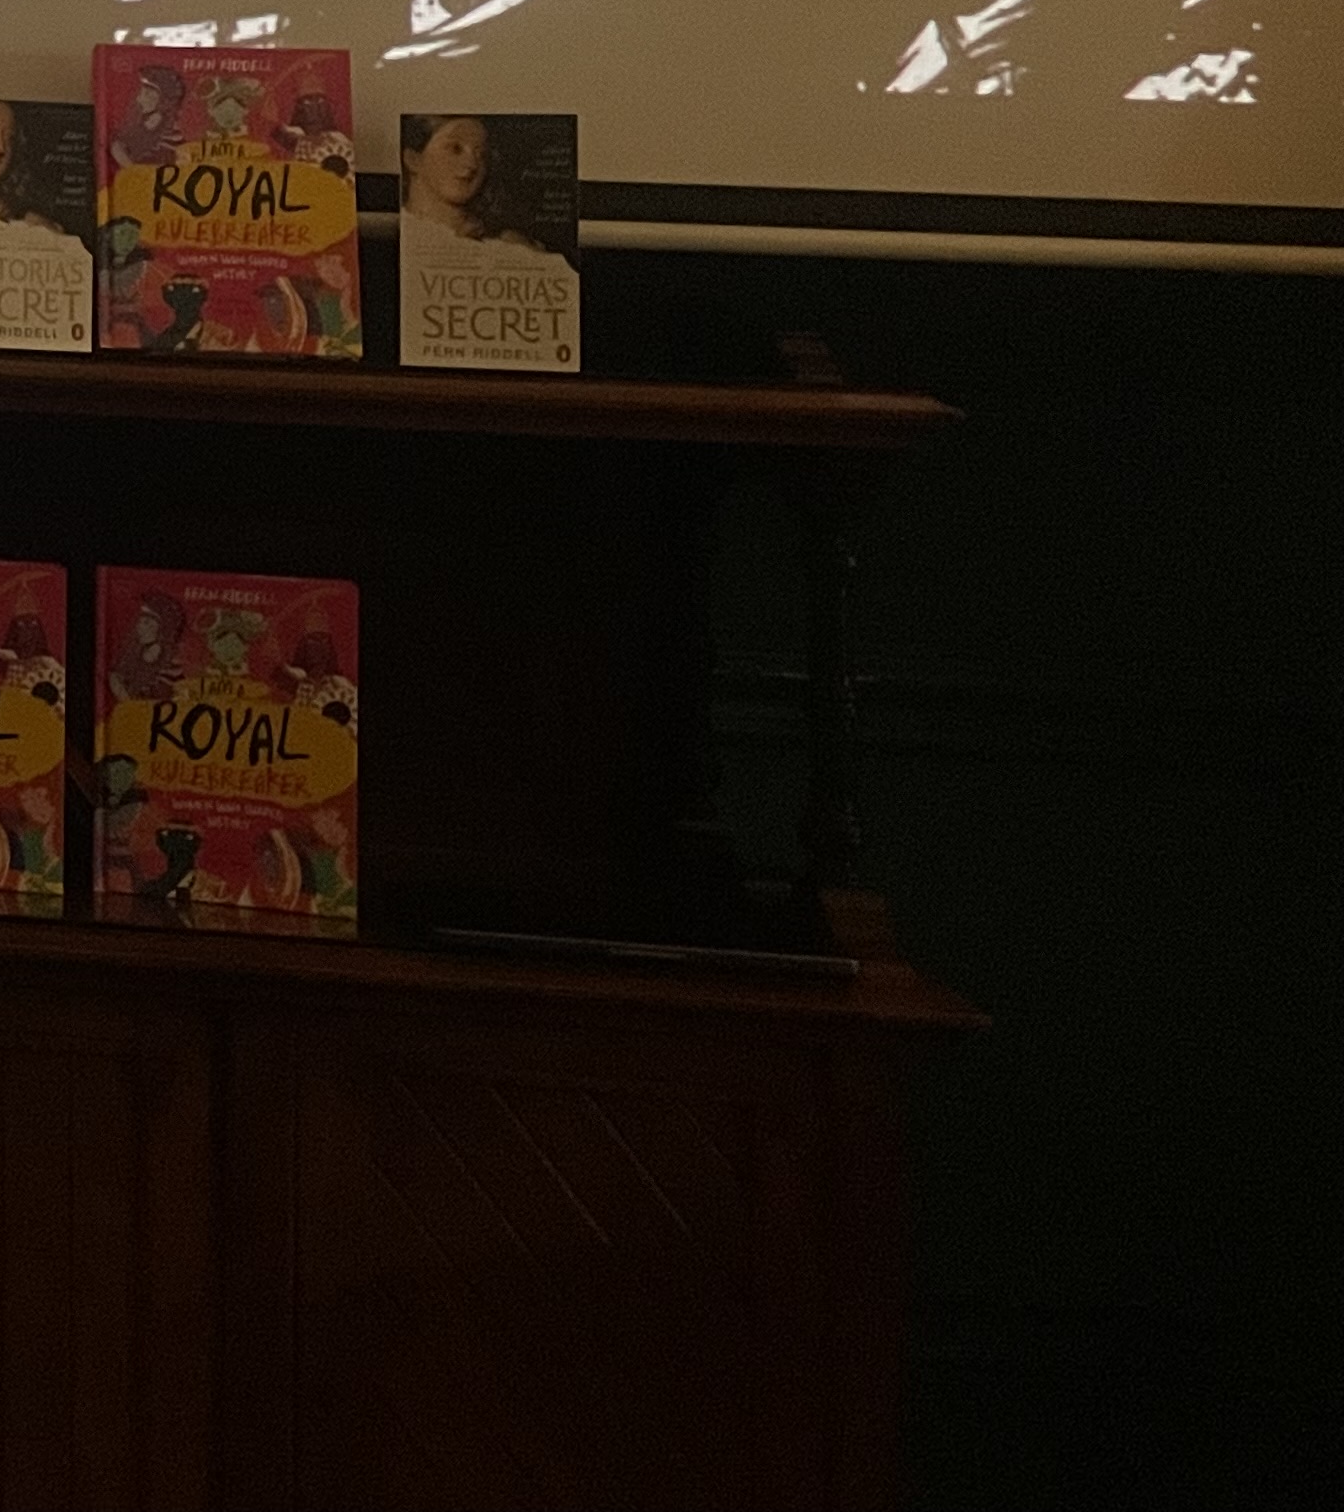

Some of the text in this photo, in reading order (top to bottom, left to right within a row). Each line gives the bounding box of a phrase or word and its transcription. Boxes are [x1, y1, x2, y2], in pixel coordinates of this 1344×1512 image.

[153, 164, 311, 220] ROYAL
[155, 219, 311, 246] RULEBREAKER
[422, 305, 568, 343] SECRET
[423, 346, 544, 361] FERN RIDDELL
[149, 700, 310, 766] ROYAL
[151, 758, 310, 796] RULEBREAKER
